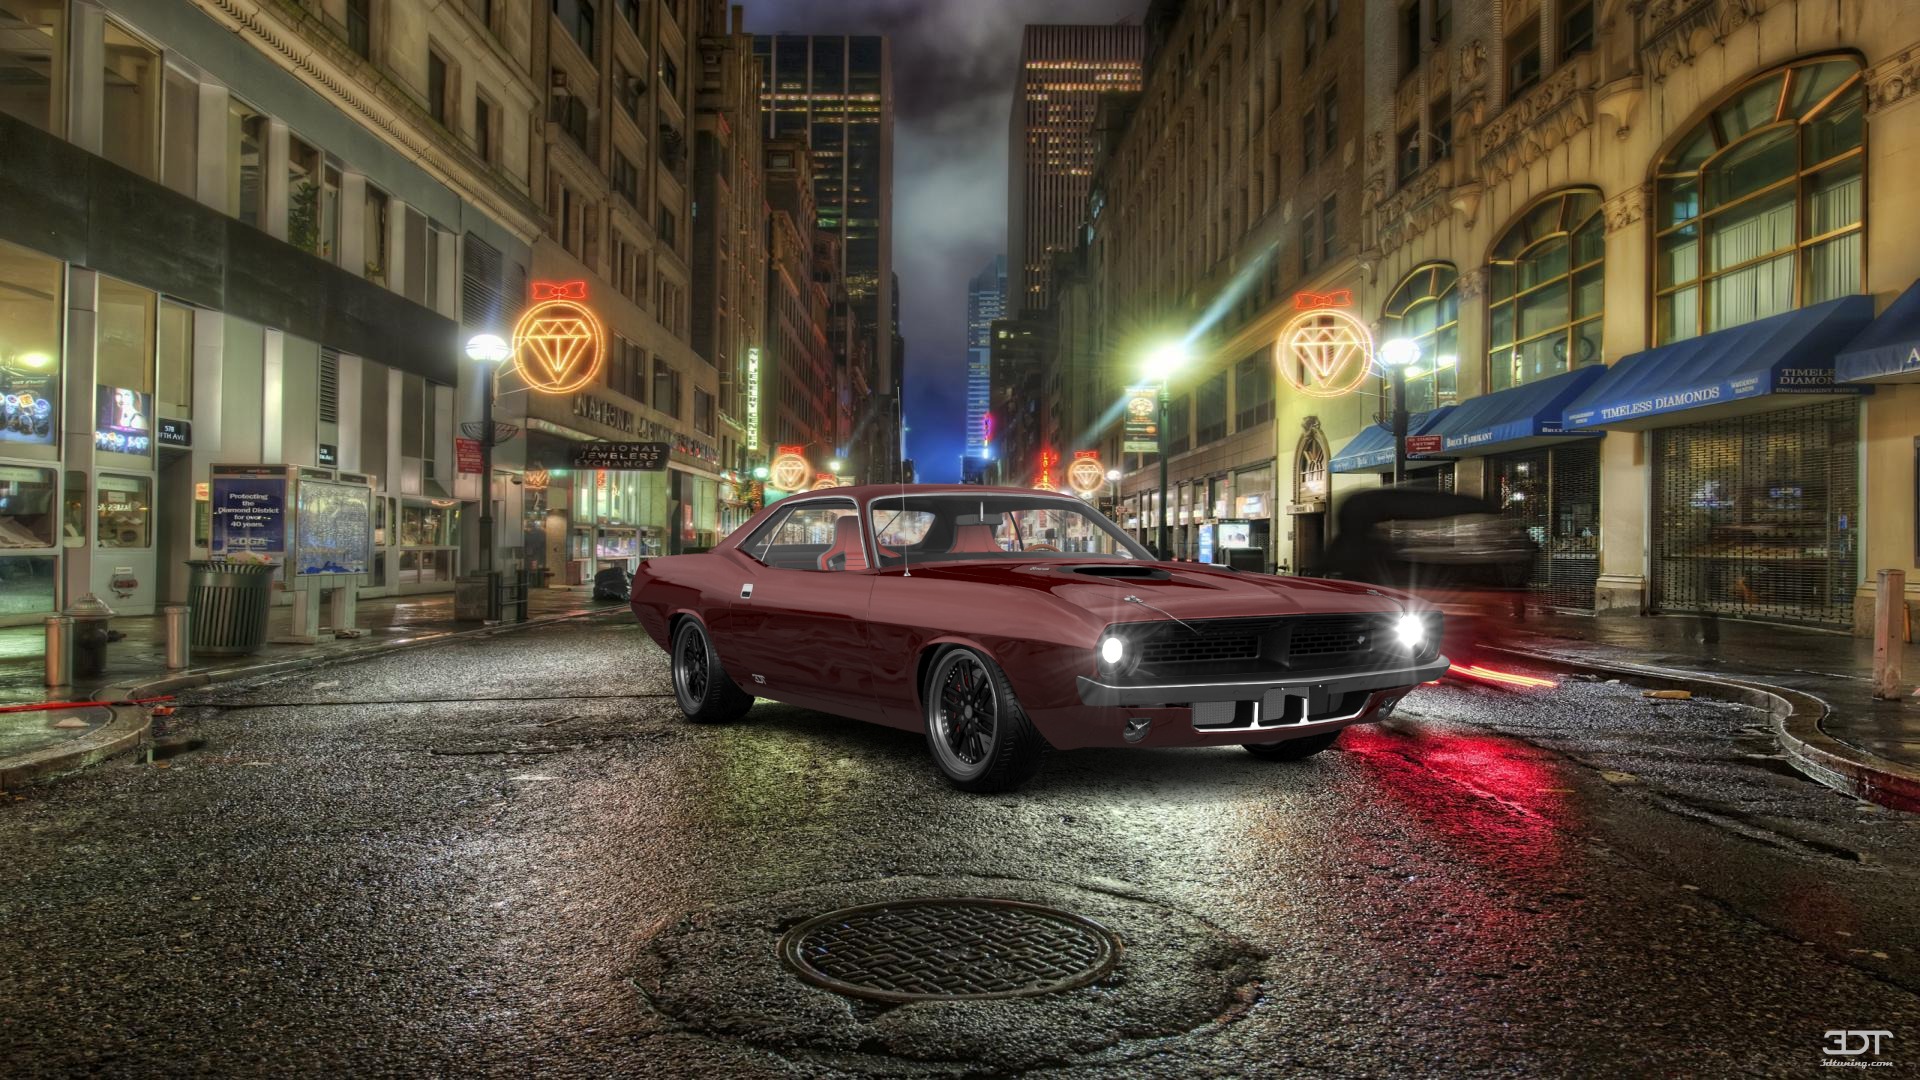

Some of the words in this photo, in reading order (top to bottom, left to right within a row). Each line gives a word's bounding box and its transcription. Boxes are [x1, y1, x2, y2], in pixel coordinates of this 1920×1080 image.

[1601, 401, 1653, 420] TIMELESS
[1655, 387, 1720, 409] DIAMONDS
[579, 443, 662, 453] NATIONAL
[579, 451, 659, 460] JEWELERS
[574, 459, 655, 468] EXCHANGE
[229, 493, 269, 501] Protecting
